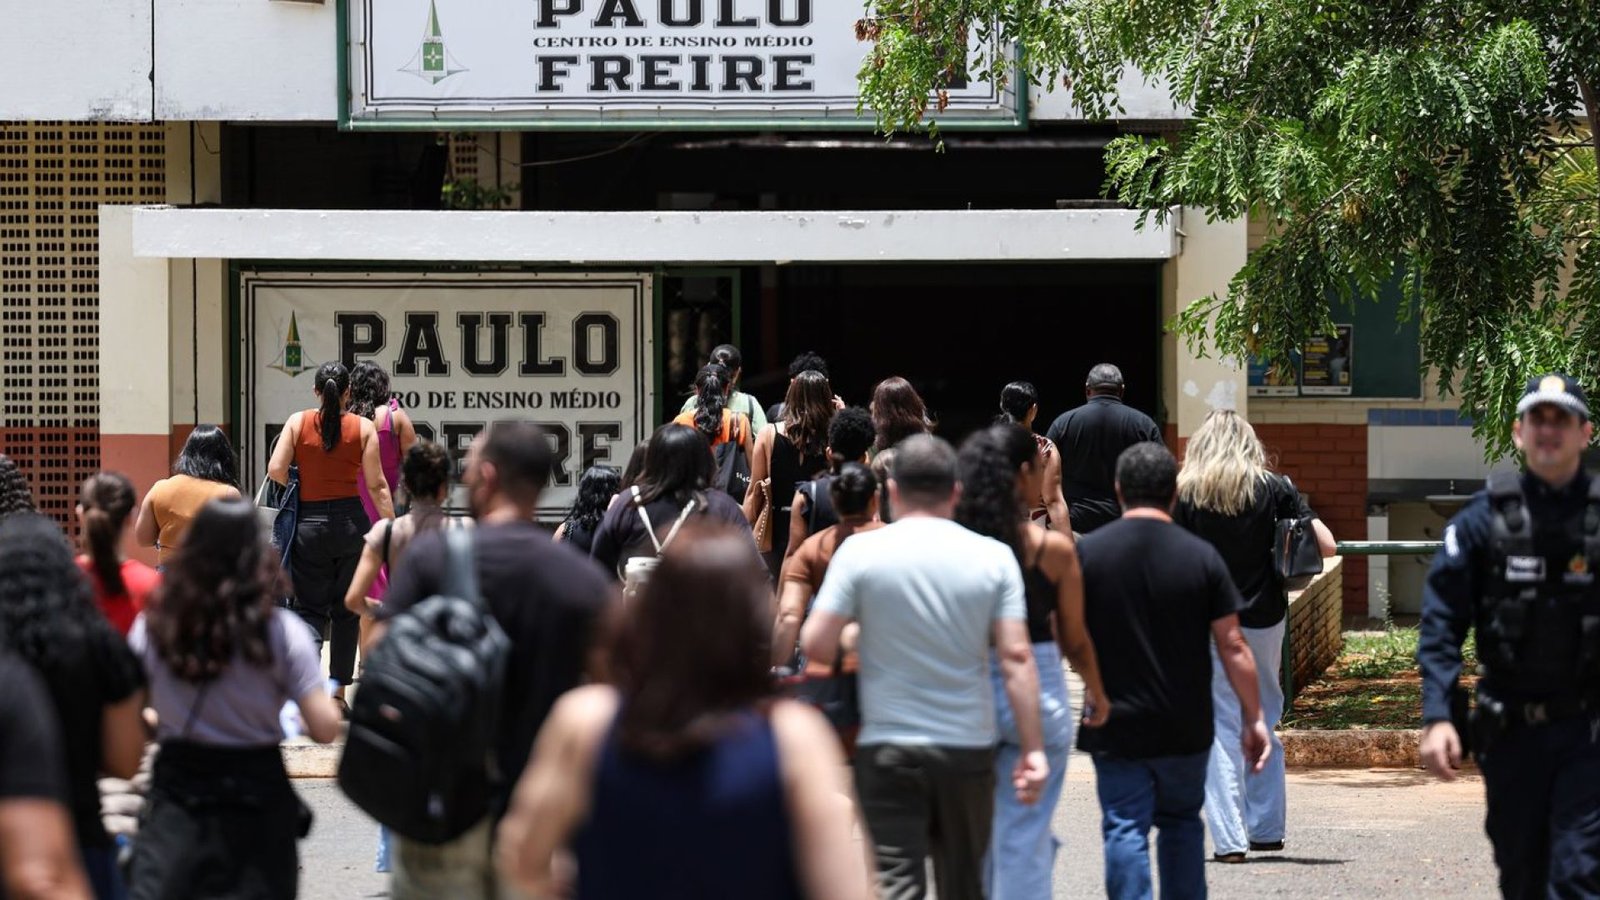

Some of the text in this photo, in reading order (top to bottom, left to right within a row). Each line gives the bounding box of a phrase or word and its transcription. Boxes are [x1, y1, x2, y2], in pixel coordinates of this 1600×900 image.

[533, 0, 813, 29] PAULO
[533, 35, 814, 48] CENTRO DE ENSINO MÉDIO
[535, 54, 815, 93] FREIRE
[334, 311, 620, 377] PAULO
[428, 391, 456, 409] DE
[463, 391, 543, 409] ENSINO
[551, 388, 621, 409] MÉDIO
